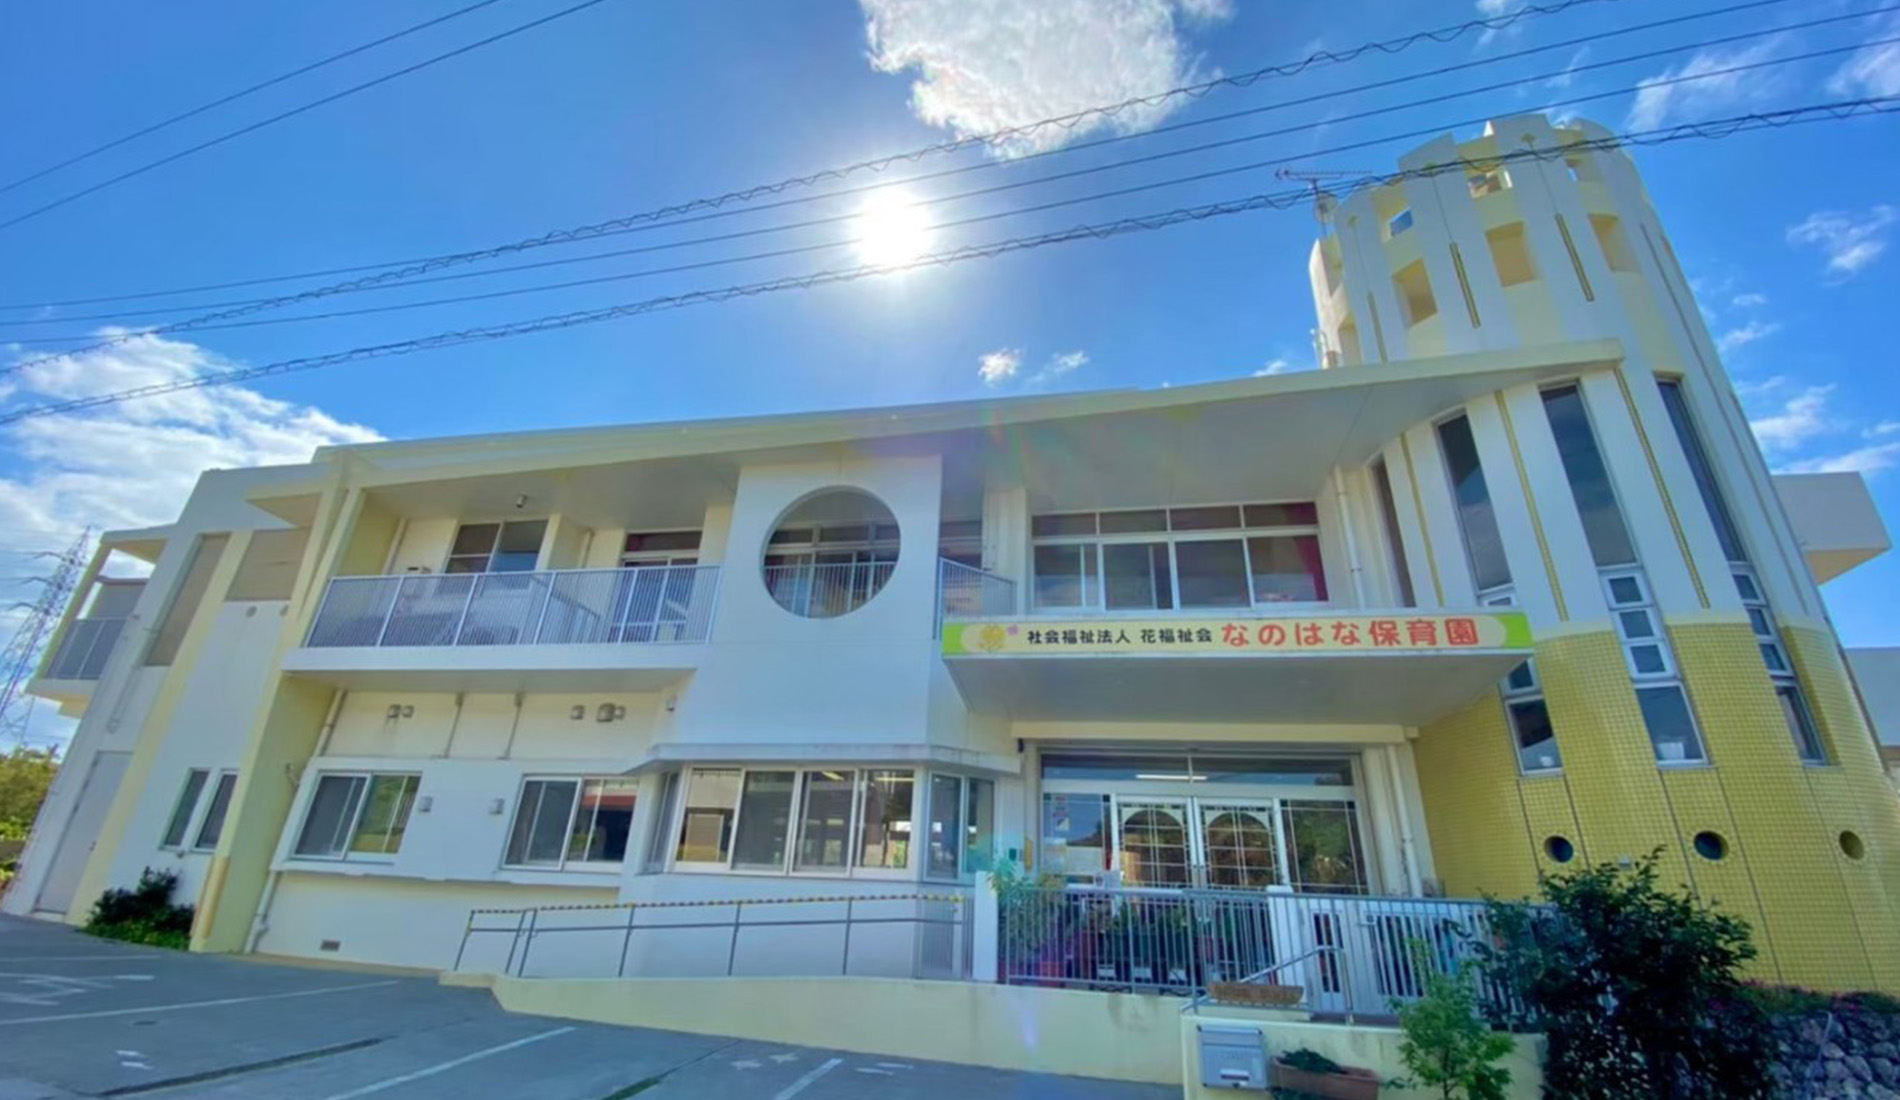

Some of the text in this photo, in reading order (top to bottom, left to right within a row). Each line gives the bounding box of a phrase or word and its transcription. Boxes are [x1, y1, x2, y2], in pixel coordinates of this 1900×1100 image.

[1027, 618, 1479, 647] 社会福祉法人 花福祉会 なのはな保育園
